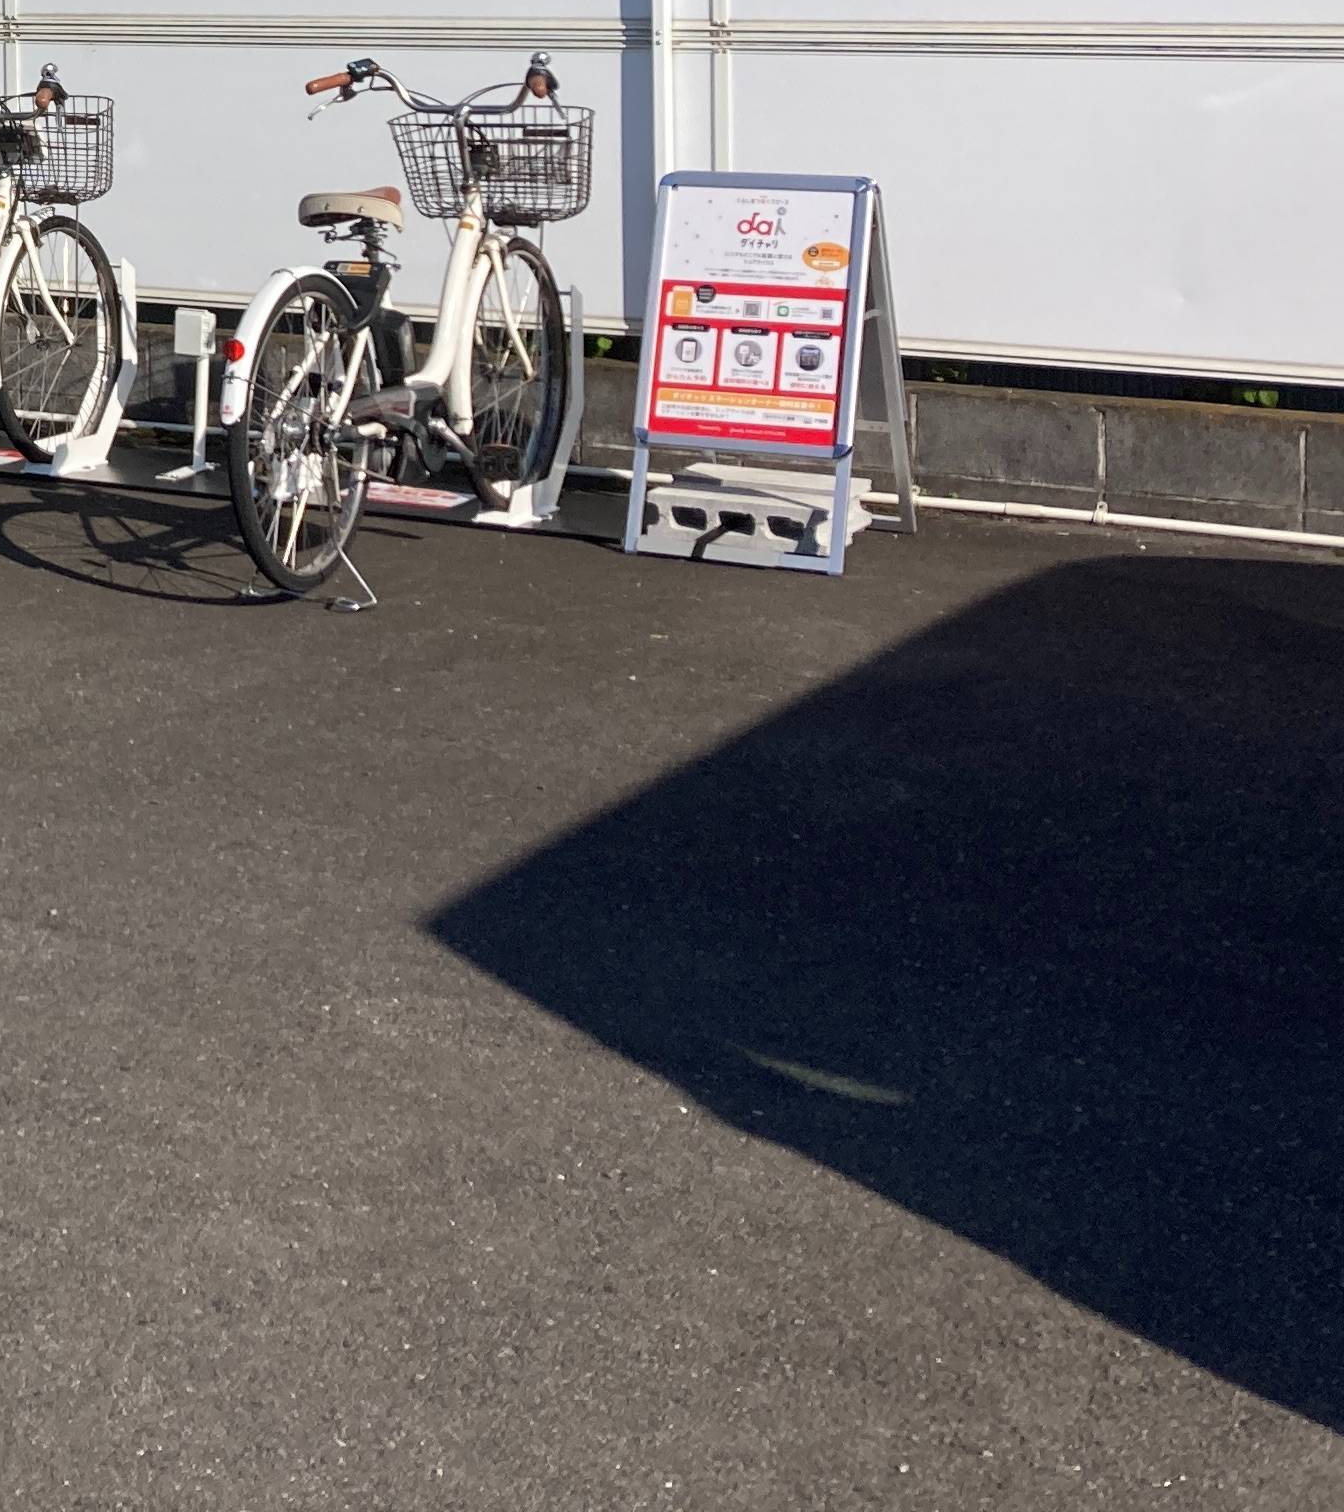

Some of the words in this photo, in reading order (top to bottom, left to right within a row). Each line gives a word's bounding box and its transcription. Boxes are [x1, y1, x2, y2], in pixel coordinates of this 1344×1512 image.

[741, 238, 779, 249] ダイチャリ
